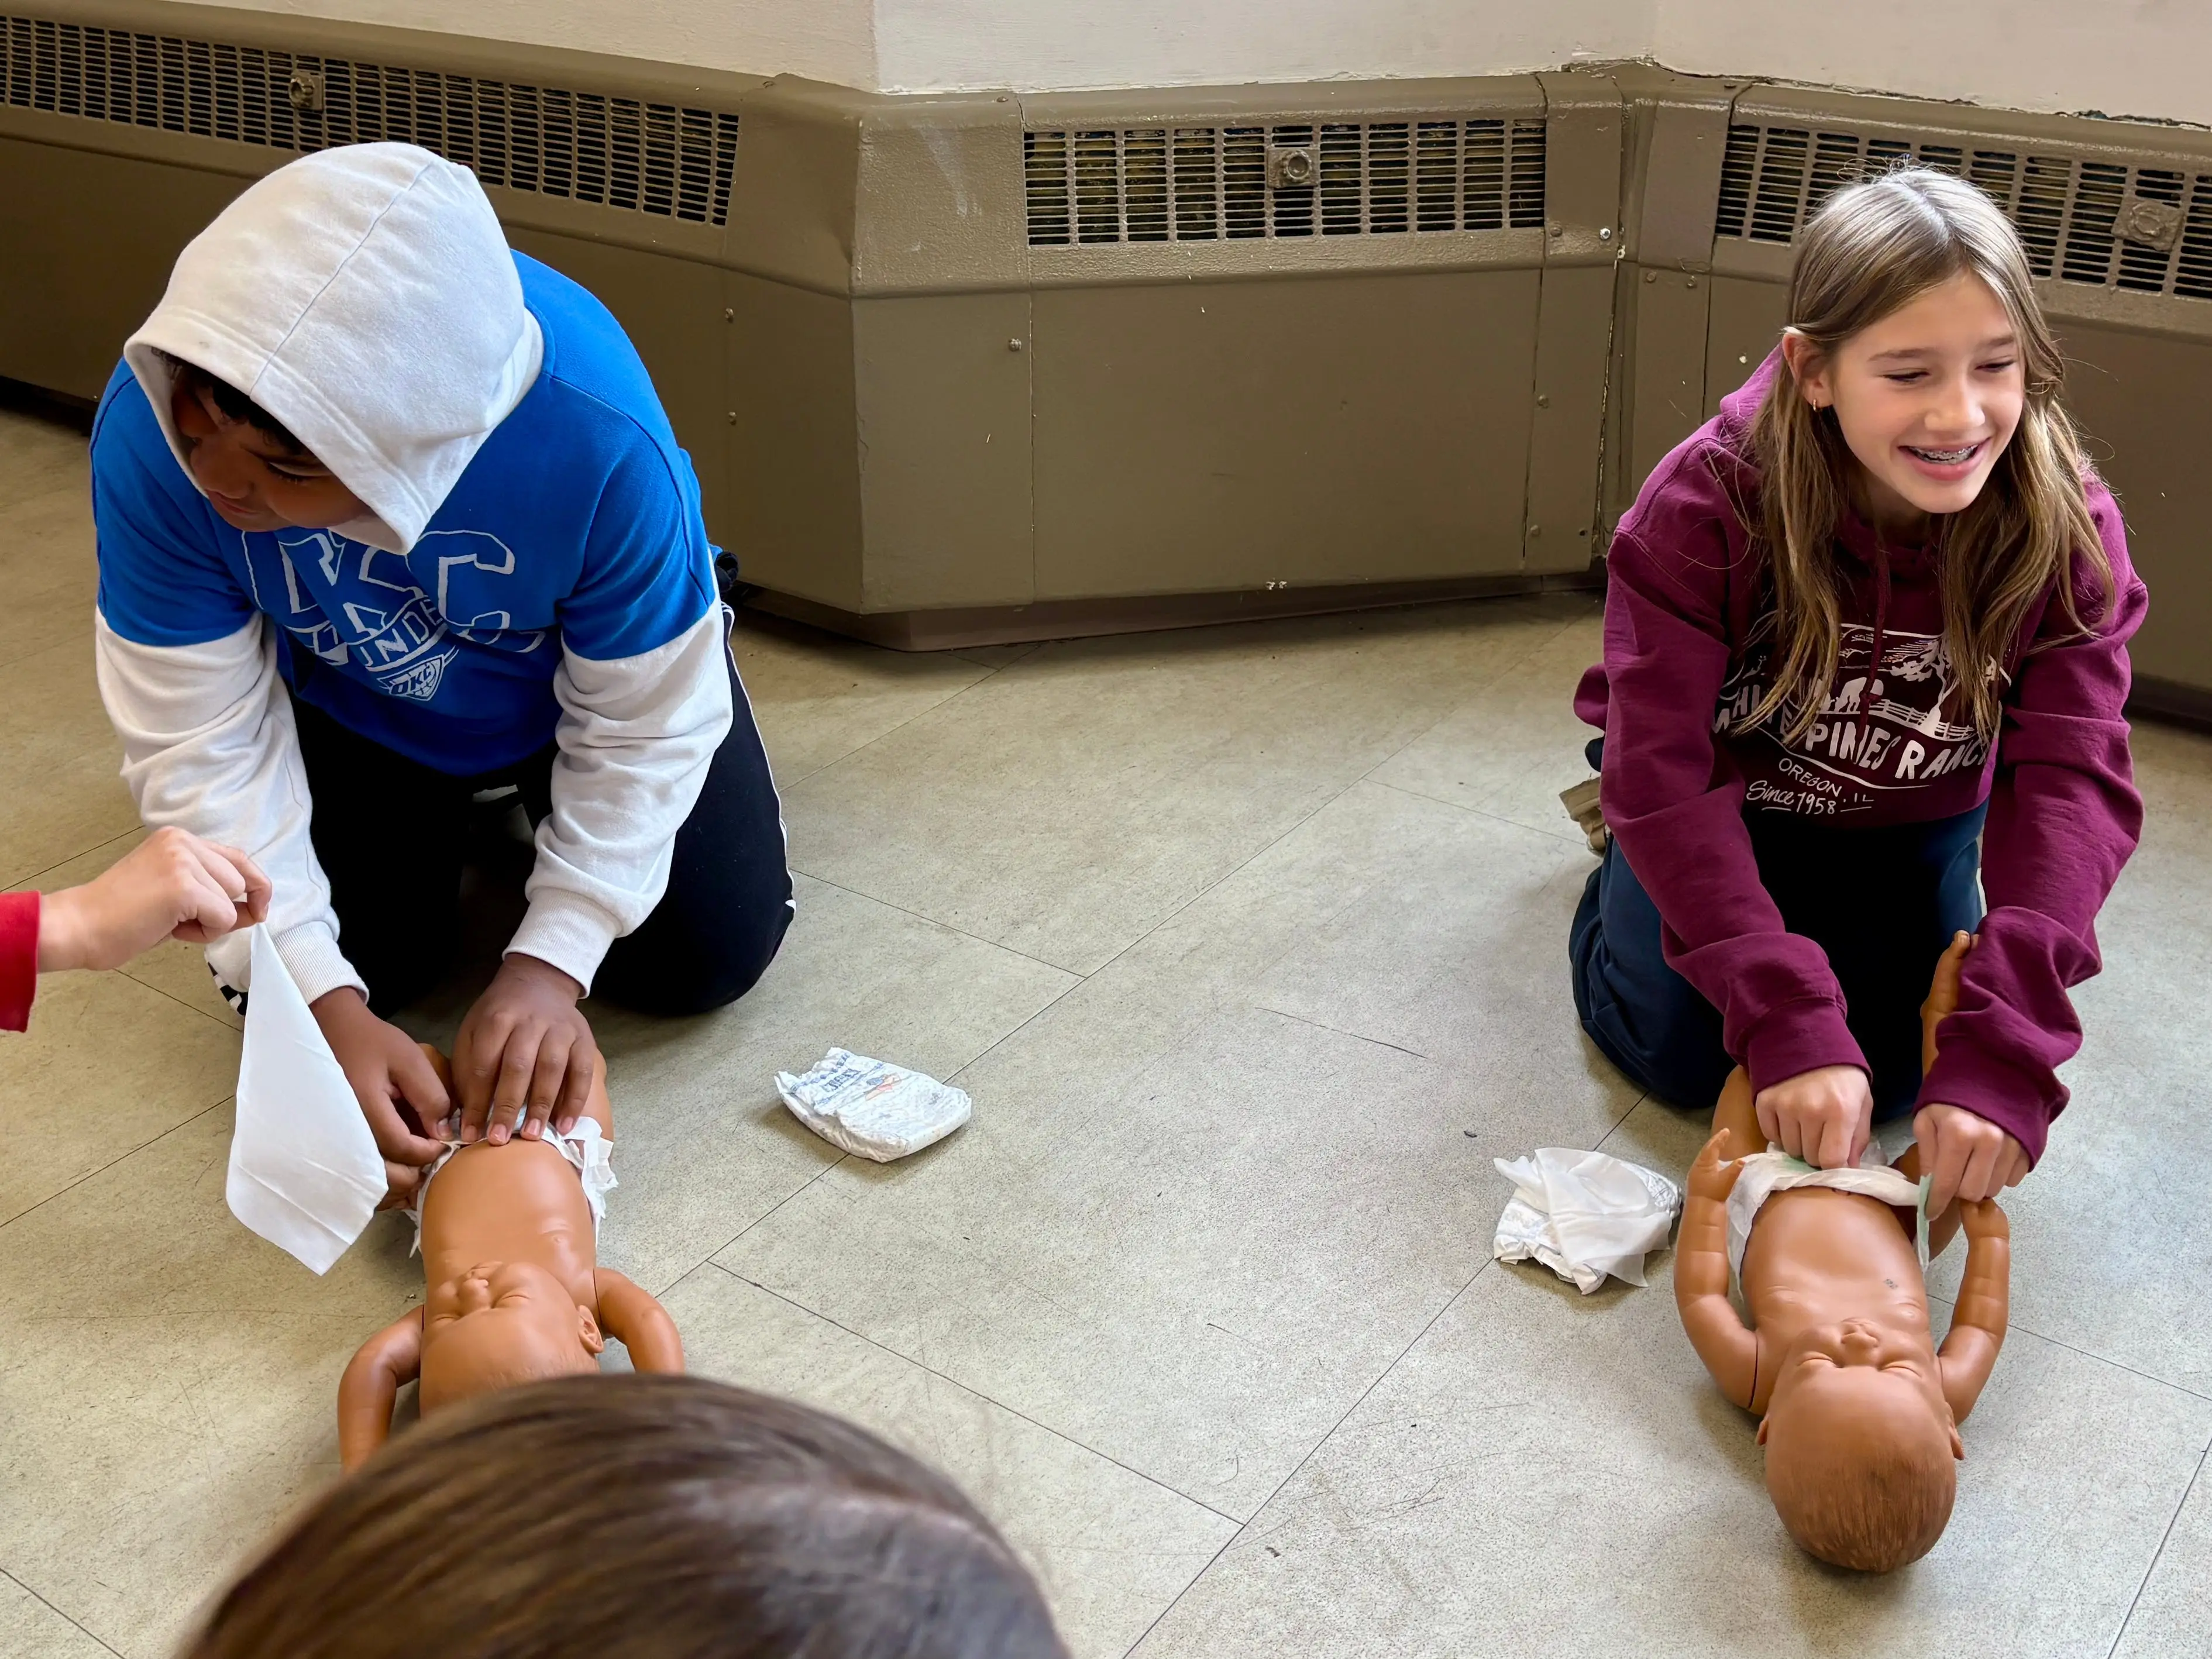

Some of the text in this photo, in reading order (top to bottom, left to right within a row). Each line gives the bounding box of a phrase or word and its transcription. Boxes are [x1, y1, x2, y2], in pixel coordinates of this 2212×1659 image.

[1805, 721, 1901, 770] PINES
[1746, 780, 1836, 815] Since 1958
